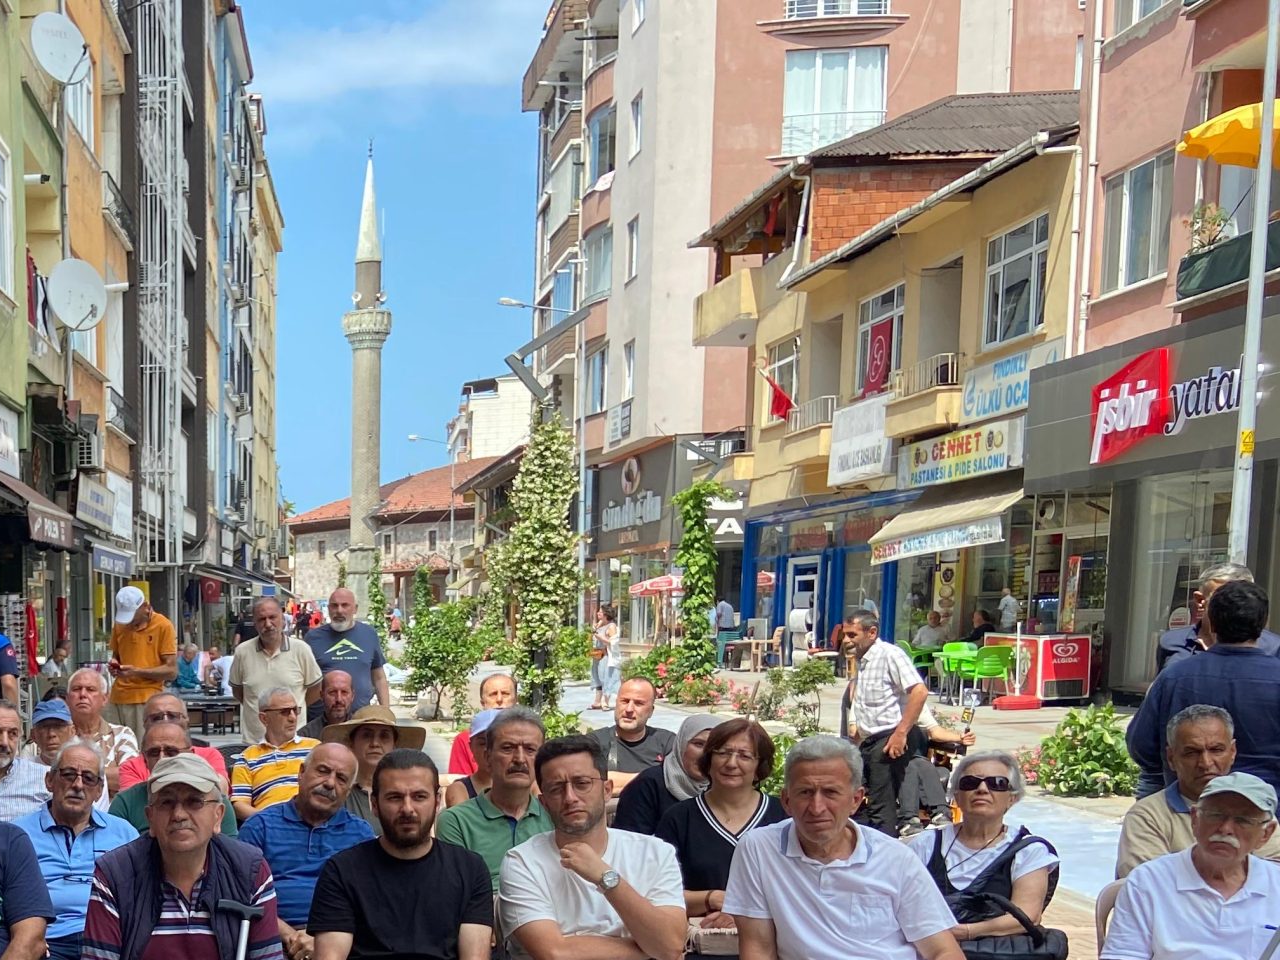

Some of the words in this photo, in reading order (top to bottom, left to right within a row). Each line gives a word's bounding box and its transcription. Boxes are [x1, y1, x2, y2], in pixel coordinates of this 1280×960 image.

[976, 383, 1002, 417] ÜLKÜ
[1163, 354, 1264, 436] yata
[931, 431, 982, 462] CENNET
[972, 452, 1005, 473] SALONU
